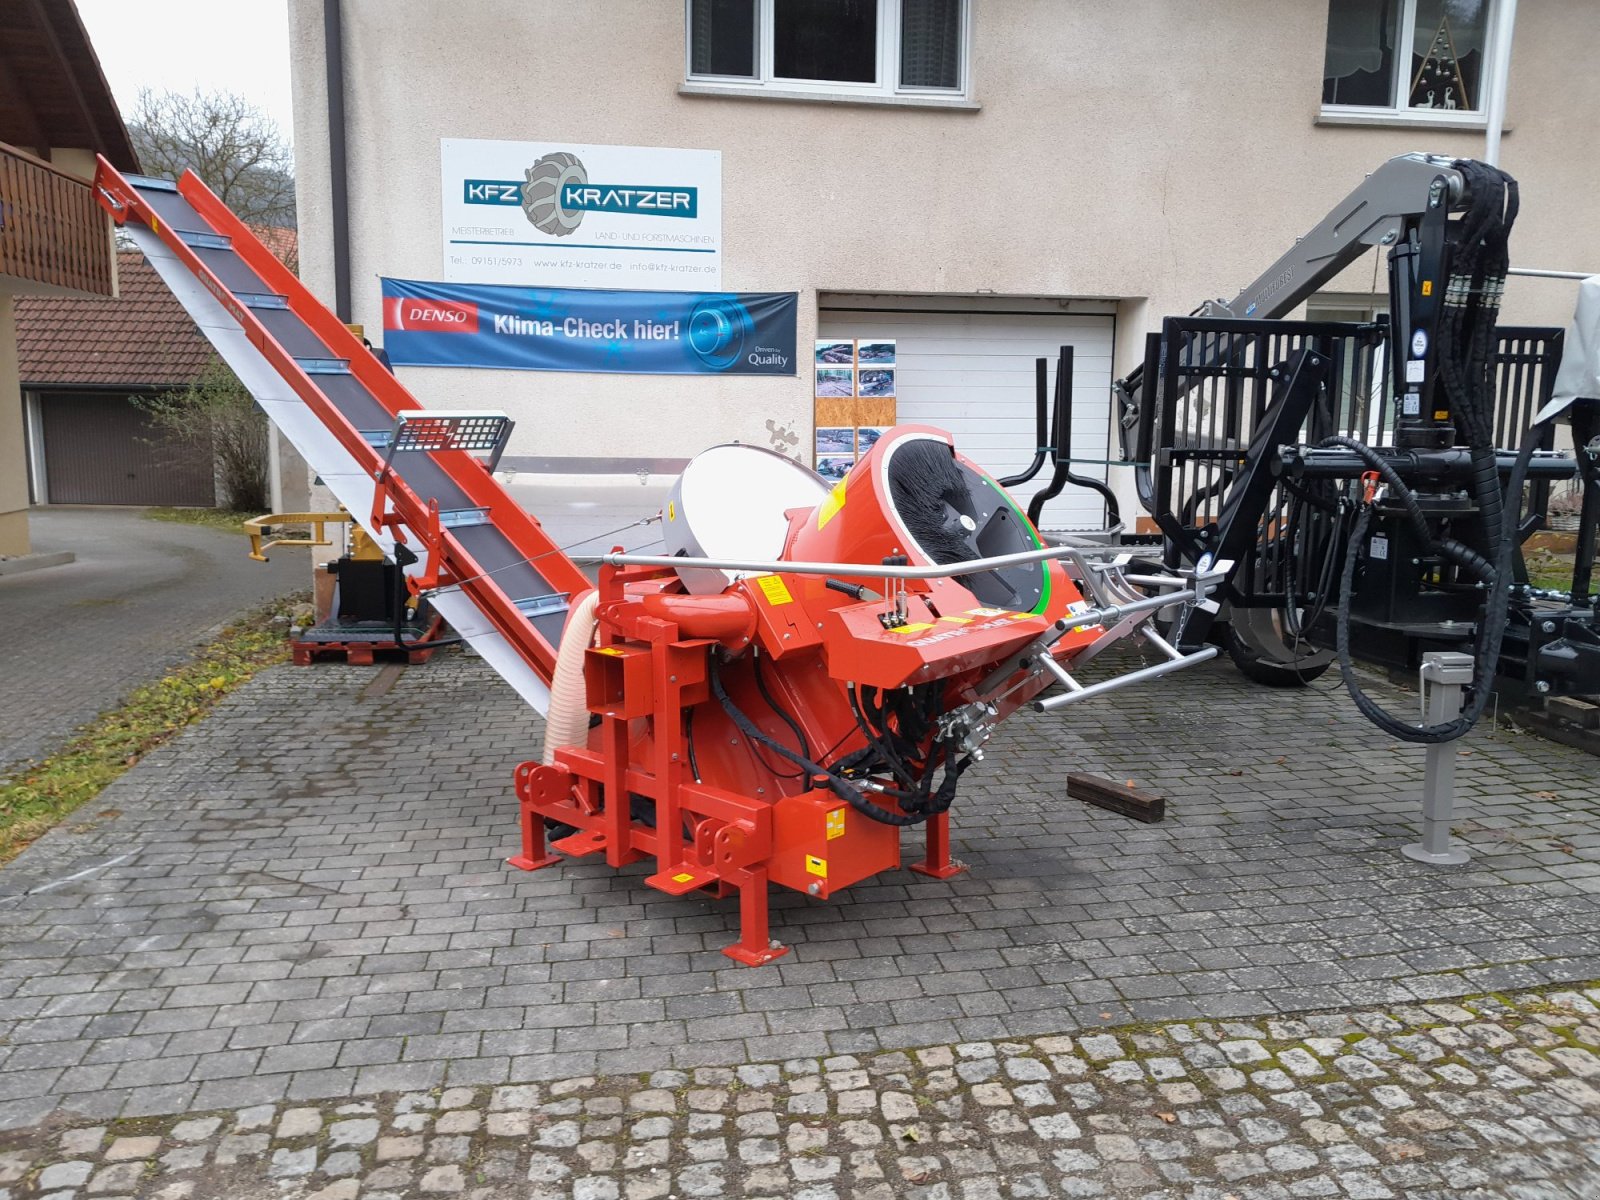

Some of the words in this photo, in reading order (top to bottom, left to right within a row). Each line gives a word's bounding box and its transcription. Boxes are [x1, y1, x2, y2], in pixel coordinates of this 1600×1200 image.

[468, 183, 519, 201] KFZ
[566, 187, 691, 210] KRATZER
[451, 226, 515, 237] MEISTERBETRIEB
[622, 232, 640, 241] UND
[641, 233, 715, 244] FORSTMASCHINEN
[471, 256, 522, 267] 09151/5973
[534, 259, 622, 270] www.kfz-kratzer.de
[630, 262, 717, 274] info@kfz-kratzer.de
[409, 308, 467, 323] DENSO
[494, 313, 628, 339] Klima-Check
[633, 319, 680, 340] hier!
[755, 345, 775, 353] Driven
[748, 353, 788, 368] Quality
